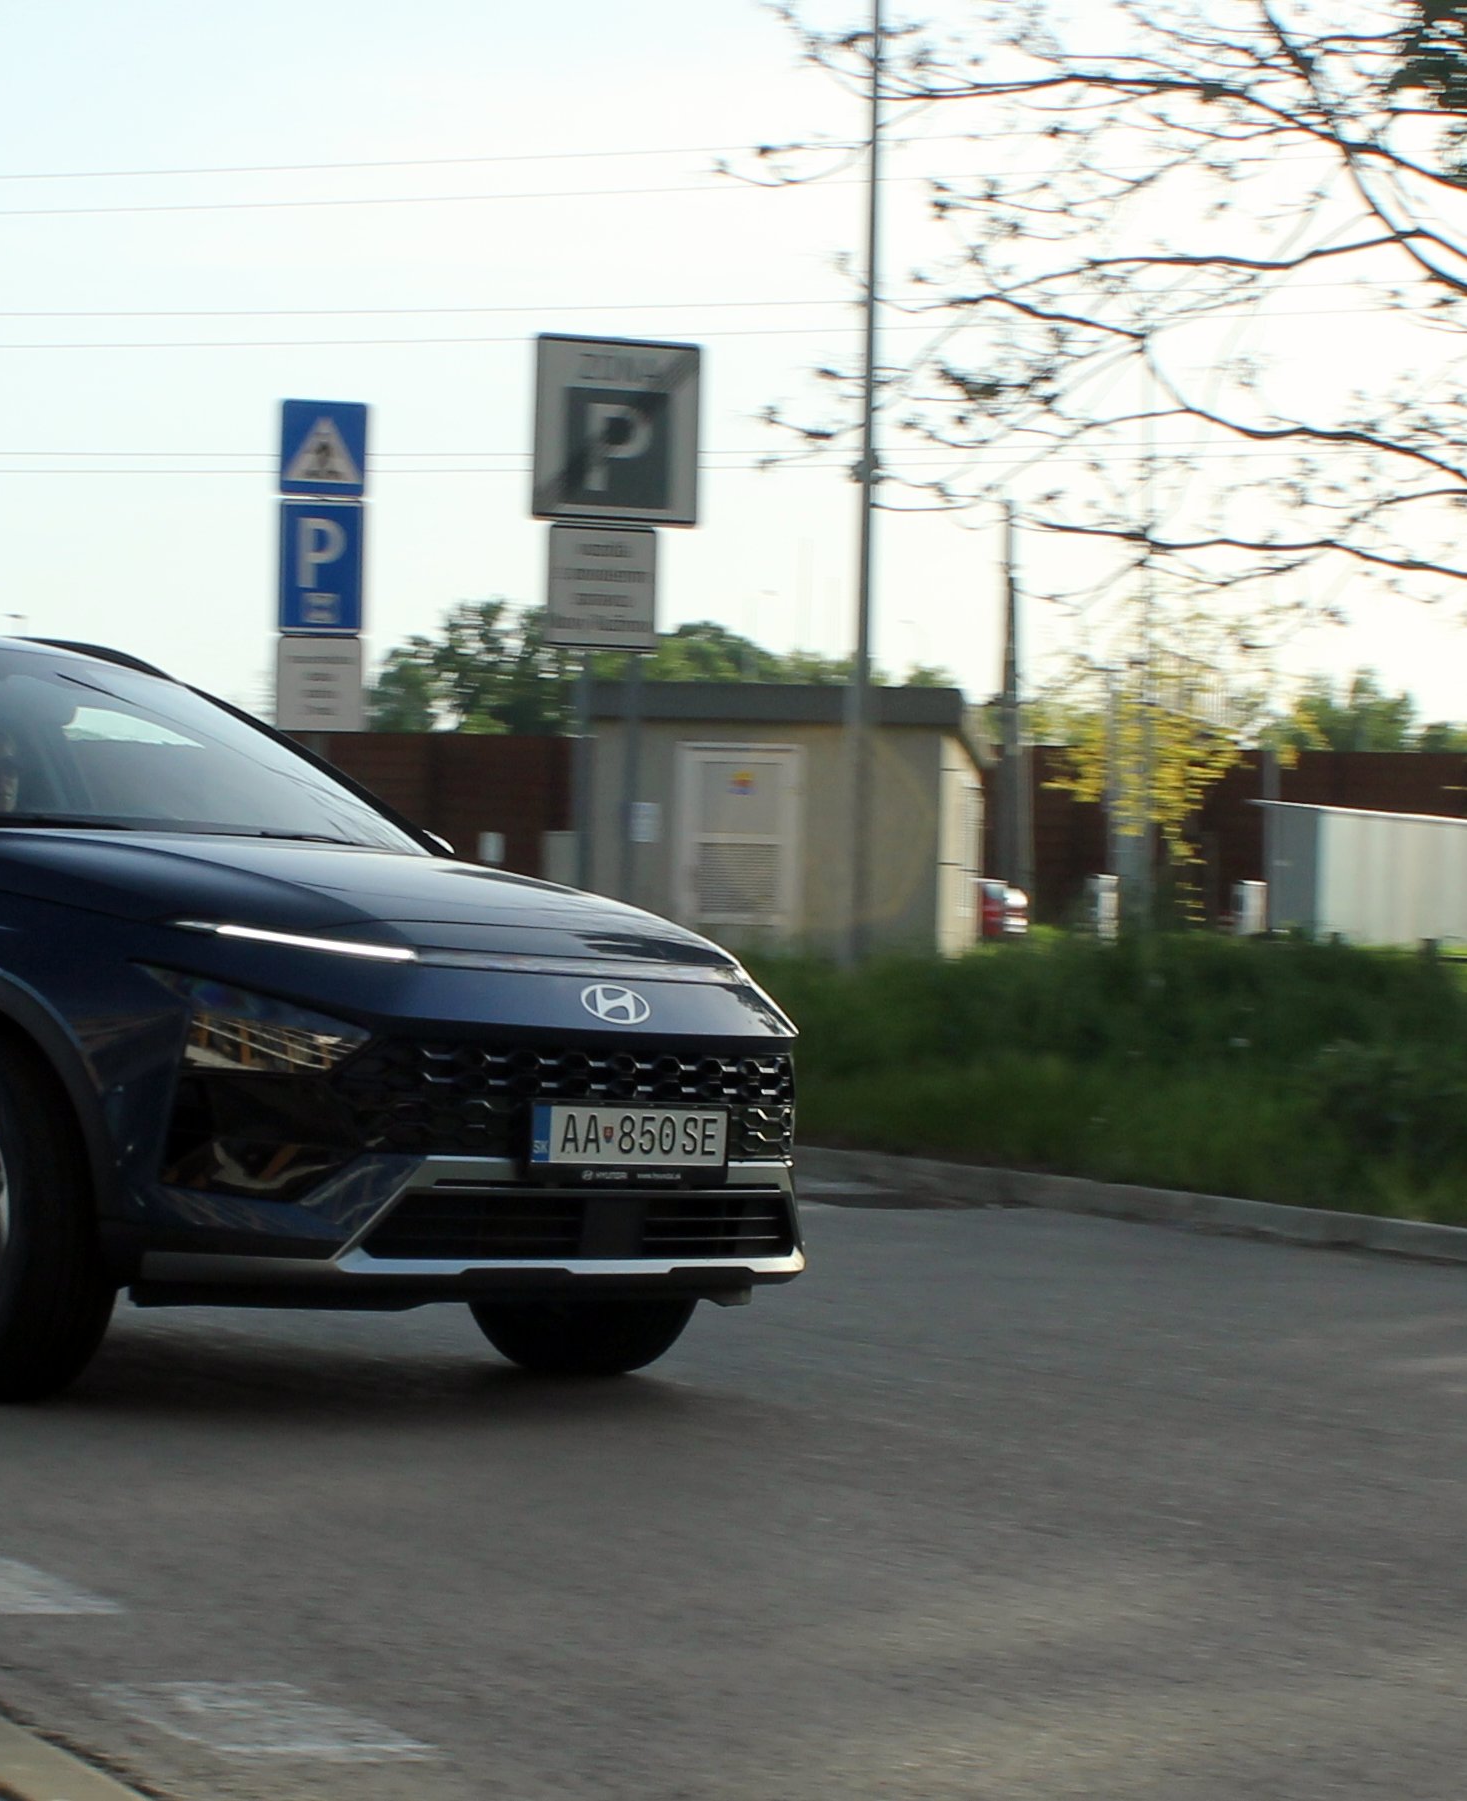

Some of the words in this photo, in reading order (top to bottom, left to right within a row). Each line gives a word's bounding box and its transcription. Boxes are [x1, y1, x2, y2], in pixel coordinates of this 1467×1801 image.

[586, 402, 653, 491] P
[297, 516, 348, 588] P
[533, 1140, 549, 1154] SK
